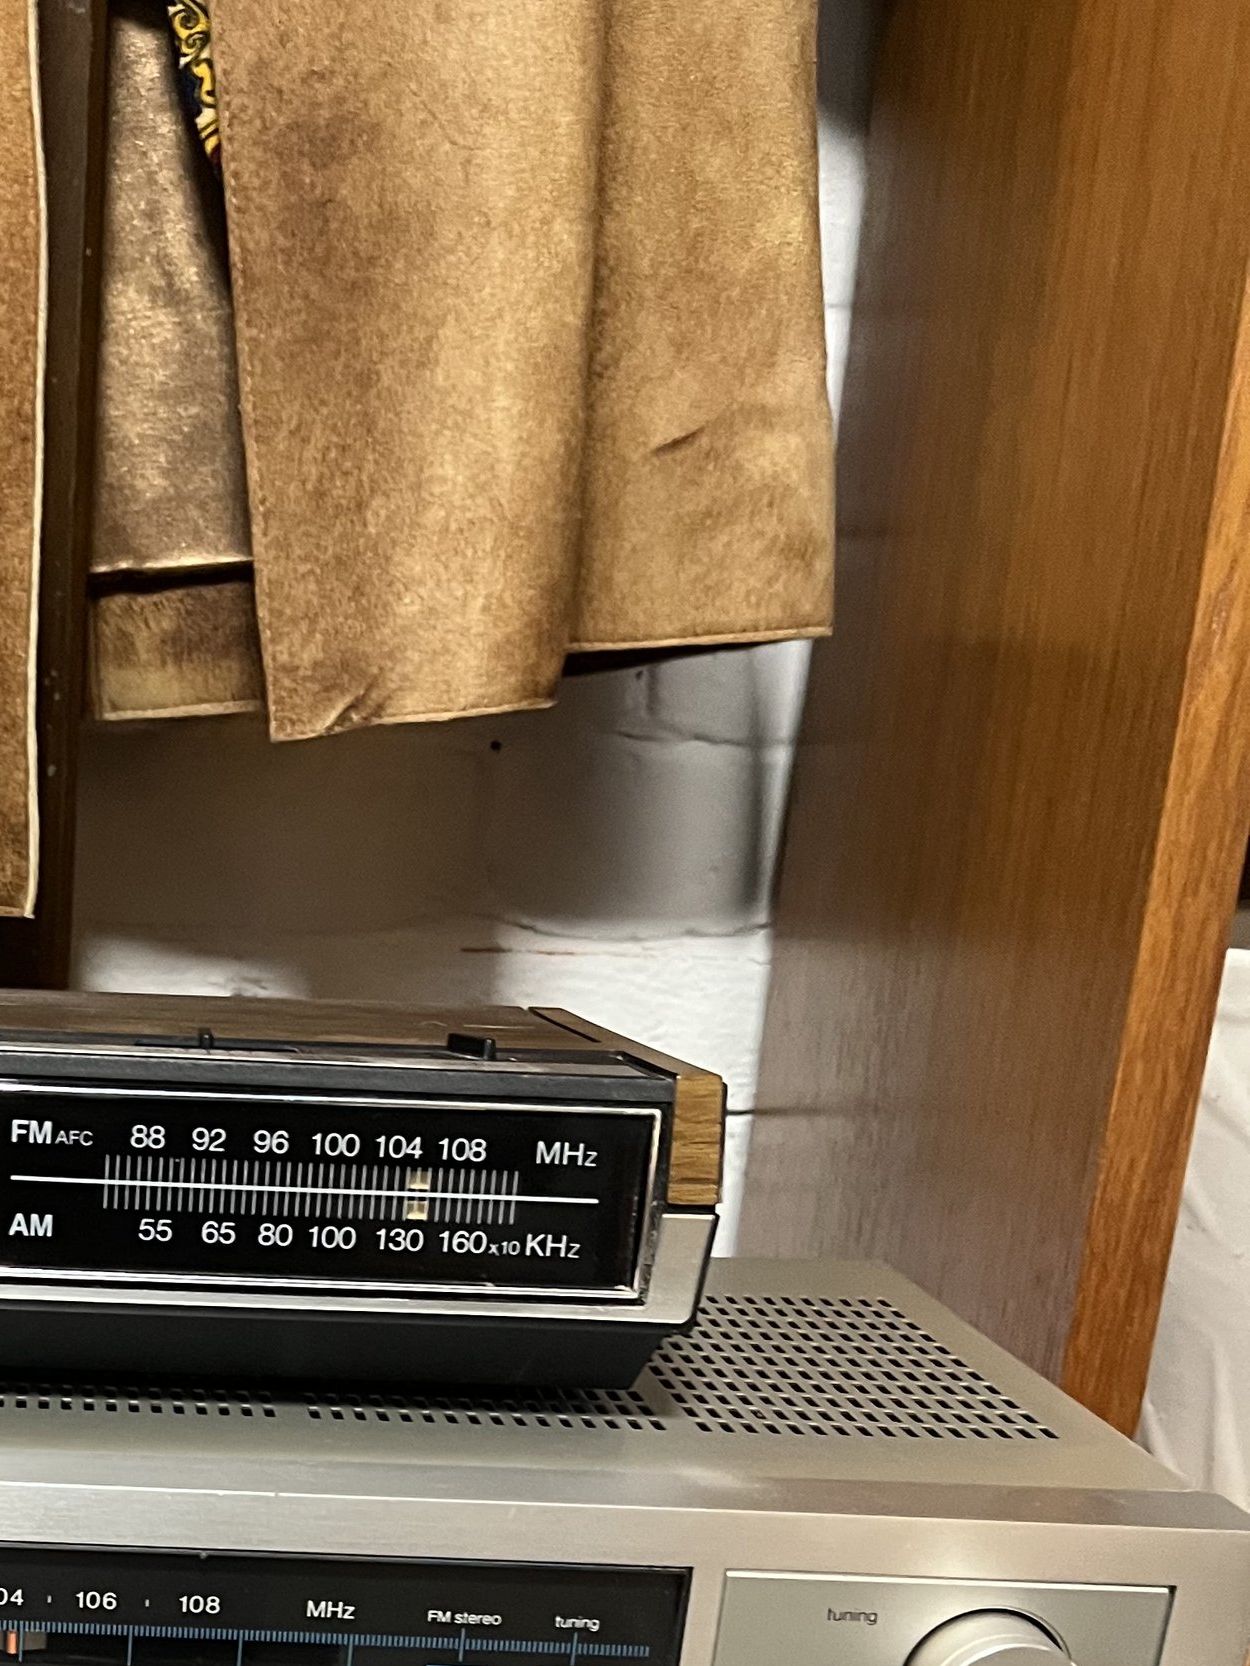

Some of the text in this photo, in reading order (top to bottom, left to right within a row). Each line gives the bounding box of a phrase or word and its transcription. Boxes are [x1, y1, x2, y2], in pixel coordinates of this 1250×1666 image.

[10, 1119, 94, 1147] FM AFC
[130, 1125, 598, 1168] 88 92 96 100 104 108 MHz
[8, 1213, 53, 1238] AM
[138, 1219, 580, 1260] 55 65 80 100 130 160 KHz
[75, 1591, 117, 1610] 106
[179, 1595, 221, 1614] 108
[305, 1600, 356, 1620] MHz
[427, 1610, 502, 1625] FM stereo
[827, 1608, 878, 1625] tuning
[554, 1616, 600, 1632] tuning
